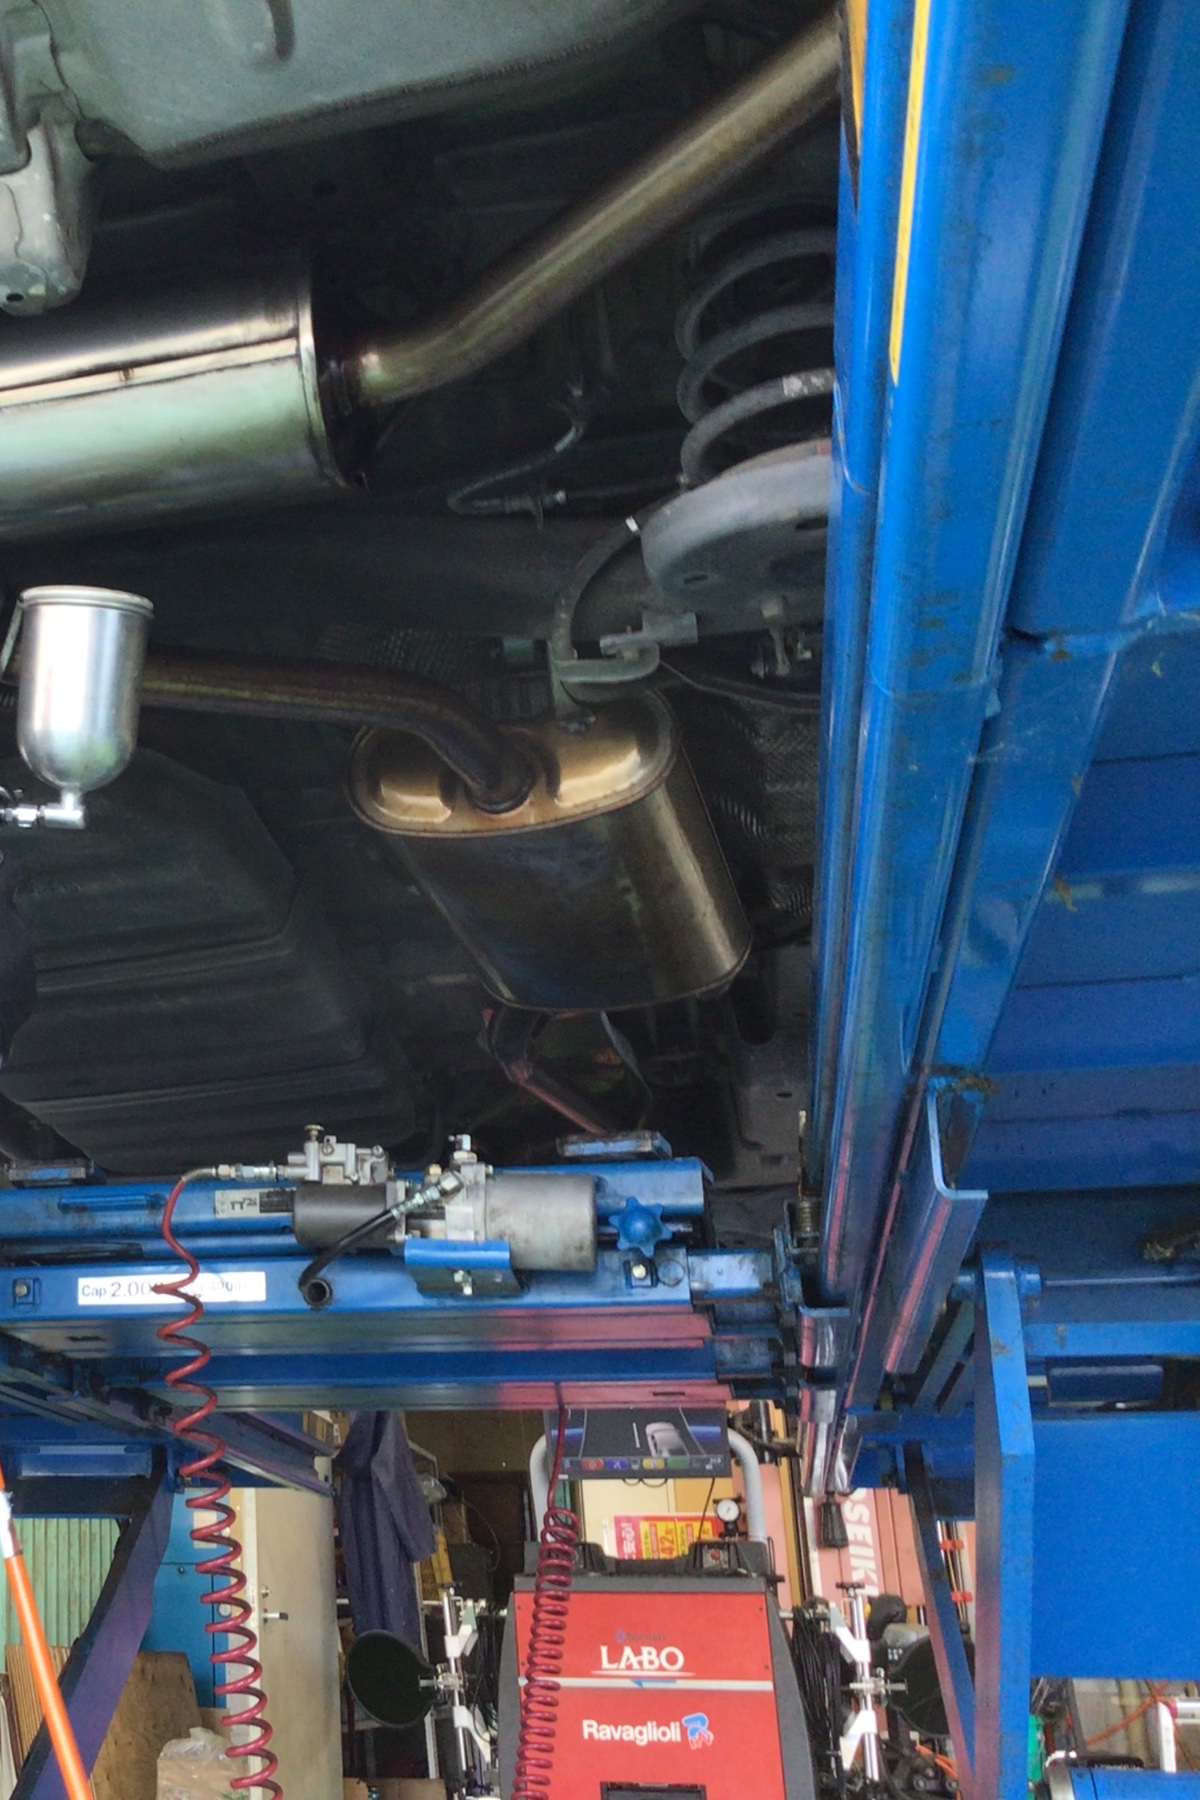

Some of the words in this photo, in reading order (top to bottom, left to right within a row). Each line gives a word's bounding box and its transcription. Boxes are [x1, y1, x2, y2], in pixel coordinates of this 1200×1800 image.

[81, 1284, 107, 1299] Cap
[599, 1645, 685, 1671] LABO
[582, 1718, 682, 1746] Ravaglioli
